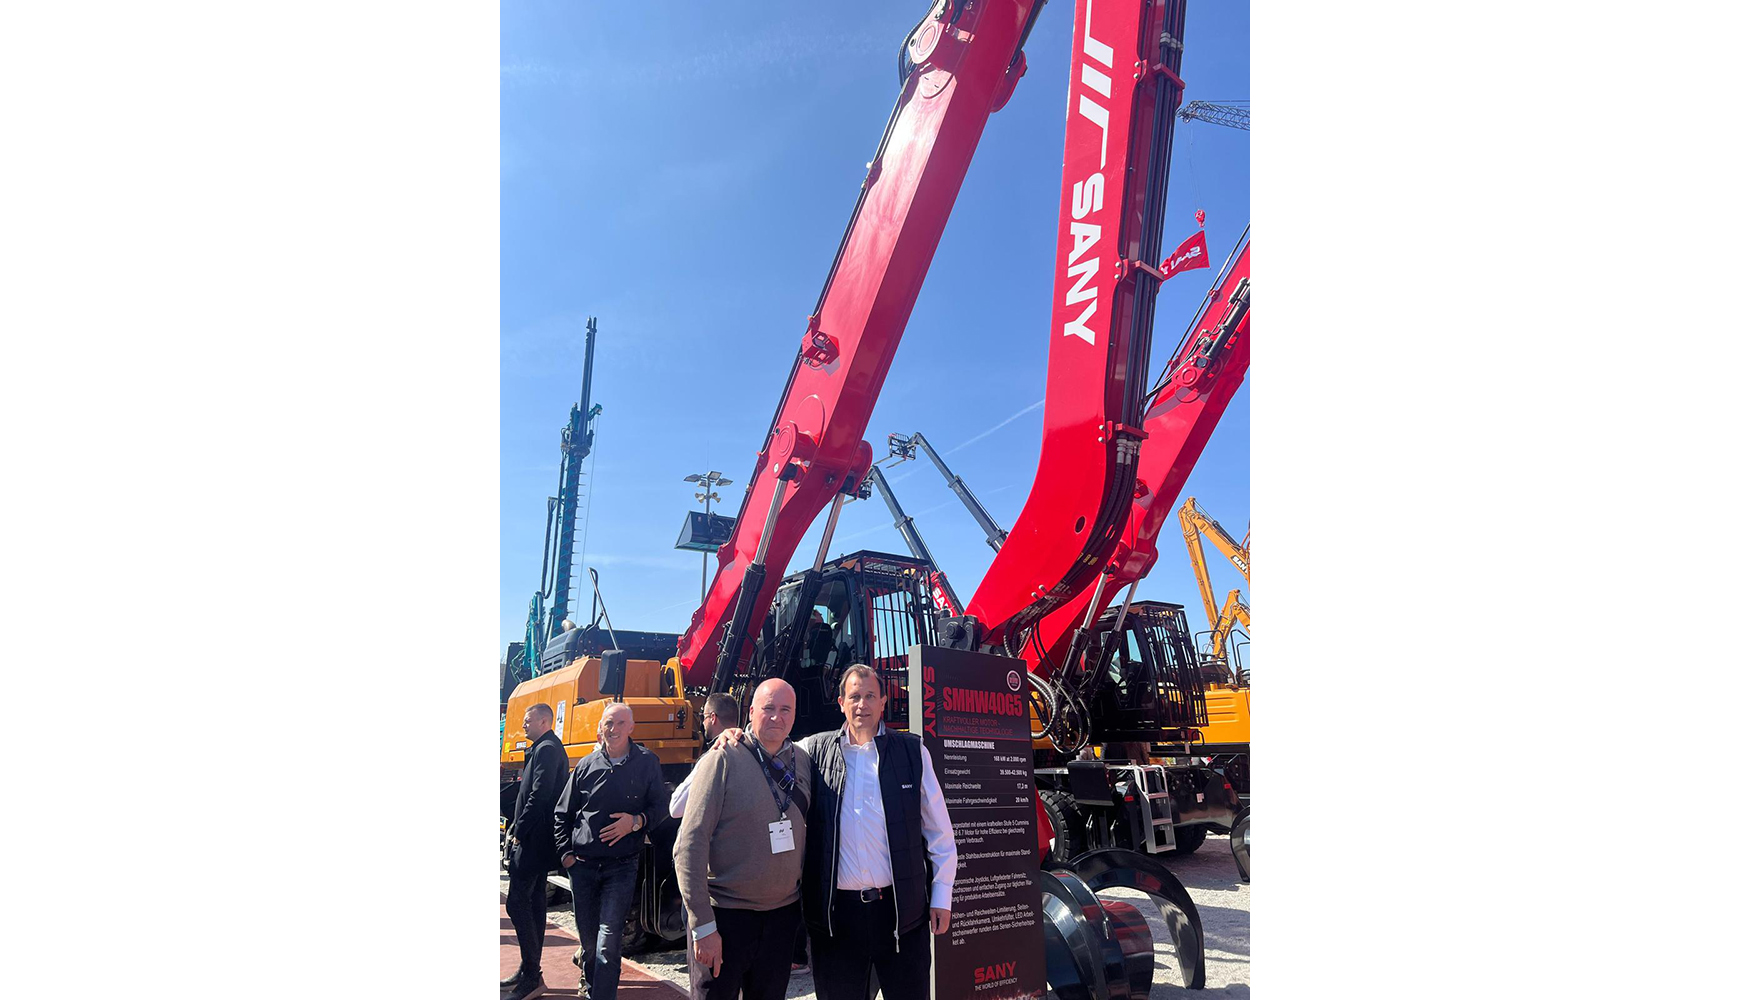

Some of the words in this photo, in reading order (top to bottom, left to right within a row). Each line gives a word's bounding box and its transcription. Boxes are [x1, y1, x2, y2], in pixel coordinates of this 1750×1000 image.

[1064, 172, 1105, 346] SANY
[1232, 556, 1248, 574] SAN
[924, 666, 936, 738] SANY
[942, 686, 1023, 716] SMHW40G5
[942, 716, 979, 726] KRAFTVOLLER
[980, 718, 998, 726] MOTOR
[943, 725, 979, 734] NACHHALTIGE
[979, 727, 1013, 736] TECHNOLOGIE
[944, 739, 995, 749] UMSCHLAGMASCHINE
[974, 961, 1016, 984] SANY
[999, 978, 1018, 986] EFFICIENCY
